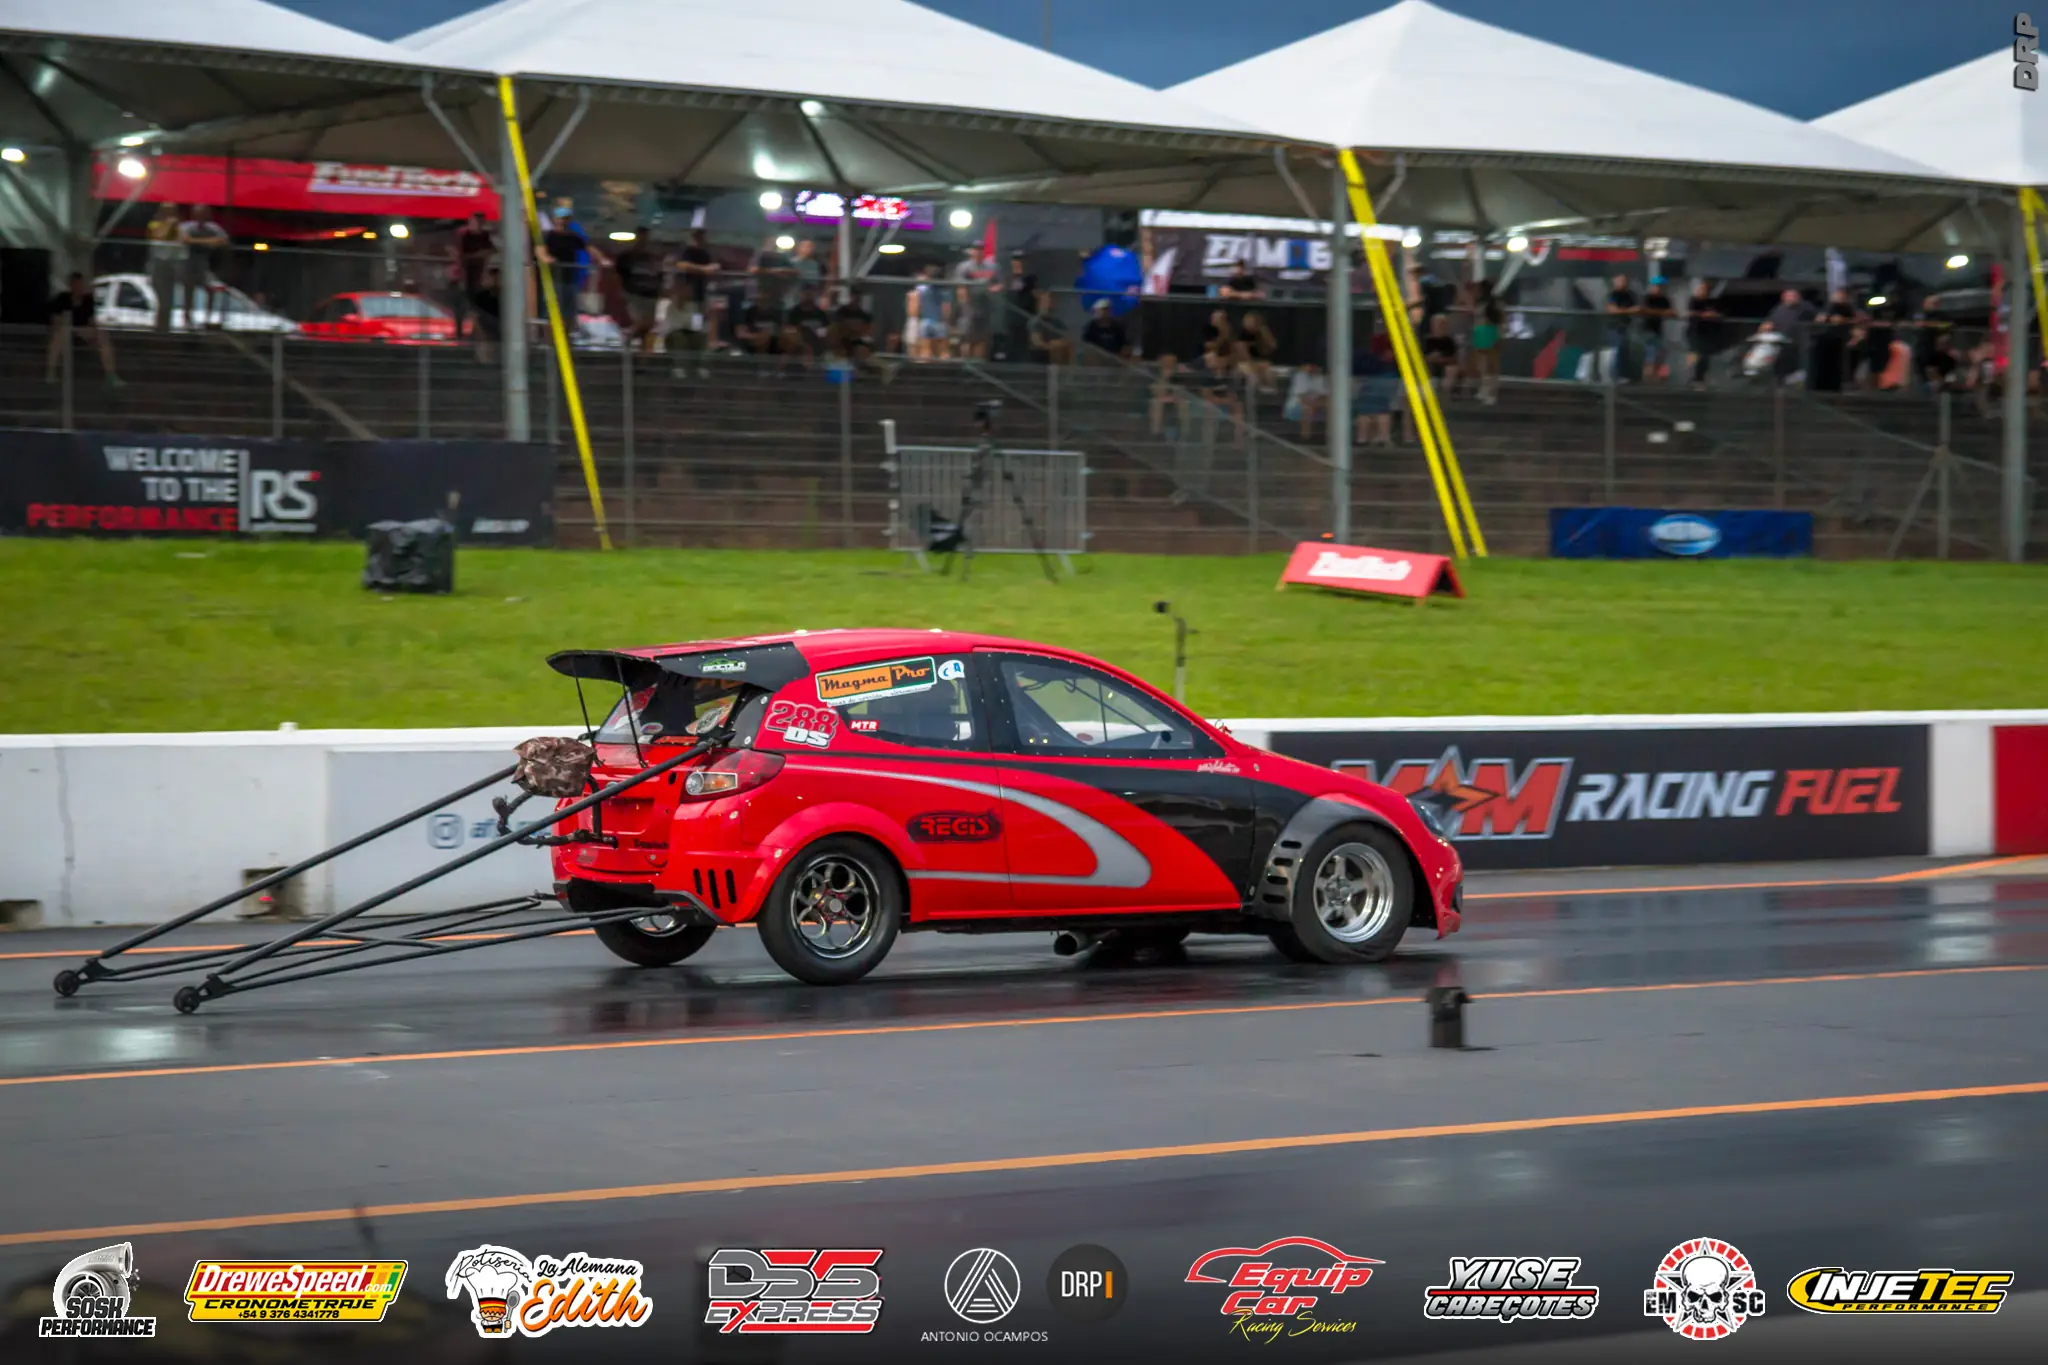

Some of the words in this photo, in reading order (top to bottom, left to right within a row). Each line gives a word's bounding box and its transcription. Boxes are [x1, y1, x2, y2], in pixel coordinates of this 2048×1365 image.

[103, 447, 239, 473] WELCOME
[142, 477, 182, 501] TO
[184, 478, 239, 502] THE
[250, 470, 321, 520] RS
[26, 503, 239, 531] PERFORMANCE
[821, 674, 889, 692] Magma
[892, 664, 931, 681] Pro
[850, 720, 877, 730] MTR
[1566, 770, 1777, 822] RACING
[1775, 767, 1903, 816] FUEL
